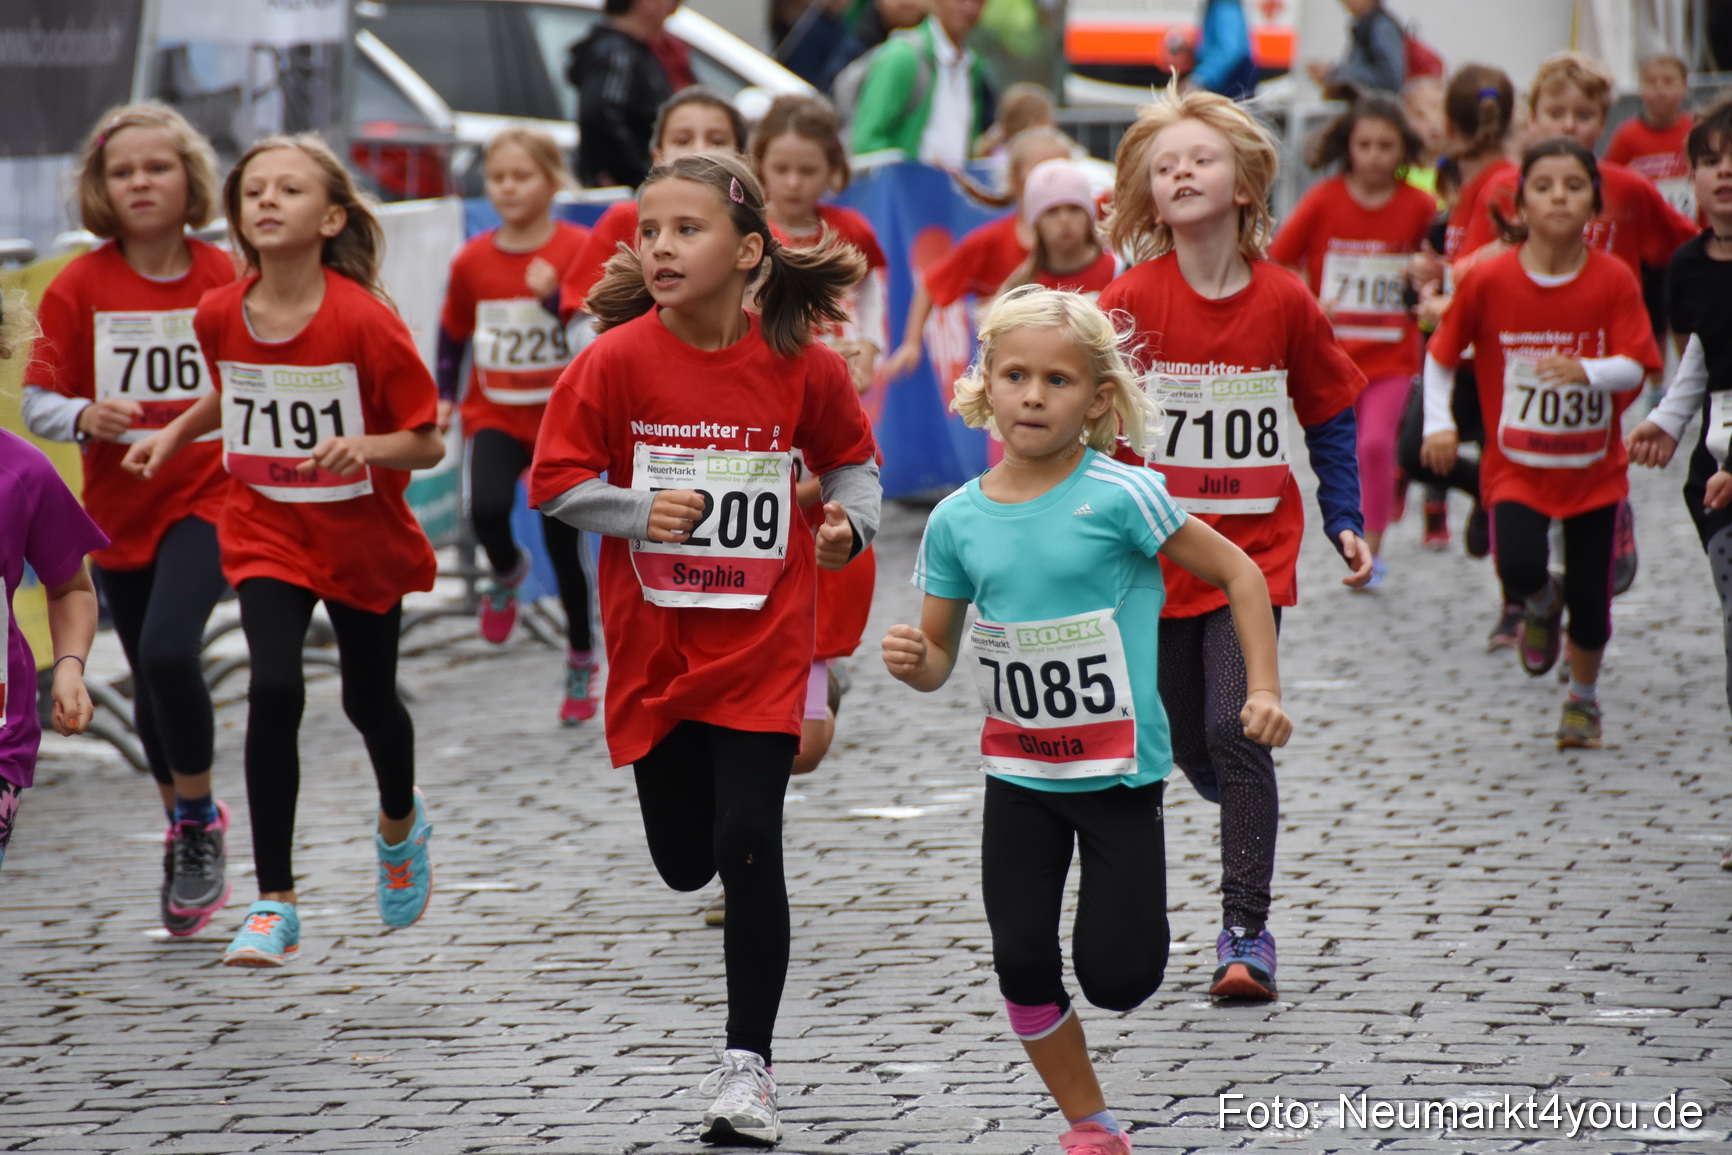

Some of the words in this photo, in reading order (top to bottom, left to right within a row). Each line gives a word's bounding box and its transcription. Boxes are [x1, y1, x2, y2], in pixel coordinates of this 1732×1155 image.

[274, 370, 344, 388] BOCK
[1212, 377, 1278, 397] BOCK
[1516, 385, 1603, 427] 7039
[233, 398, 344, 450] 7191
[631, 420, 739, 438] Neumarkter
[1161, 407, 1279, 460] 7108
[647, 465, 696, 476] NeuerMarkt
[707, 456, 781, 477] BOCK
[1199, 475, 1241, 494] Jule
[650, 487, 779, 550] 209
[635, 540, 641, 550] 3
[778, 546, 783, 556] K
[672, 563, 745, 591] Sophia
[970, 635, 1010, 649] NeuerMarkt
[1016, 618, 1106, 646] BOCK
[1046, 645, 1055, 653] by
[979, 654, 1115, 719] 7085
[1121, 706, 1129, 717] K
[1018, 734, 1084, 757] Gloria
